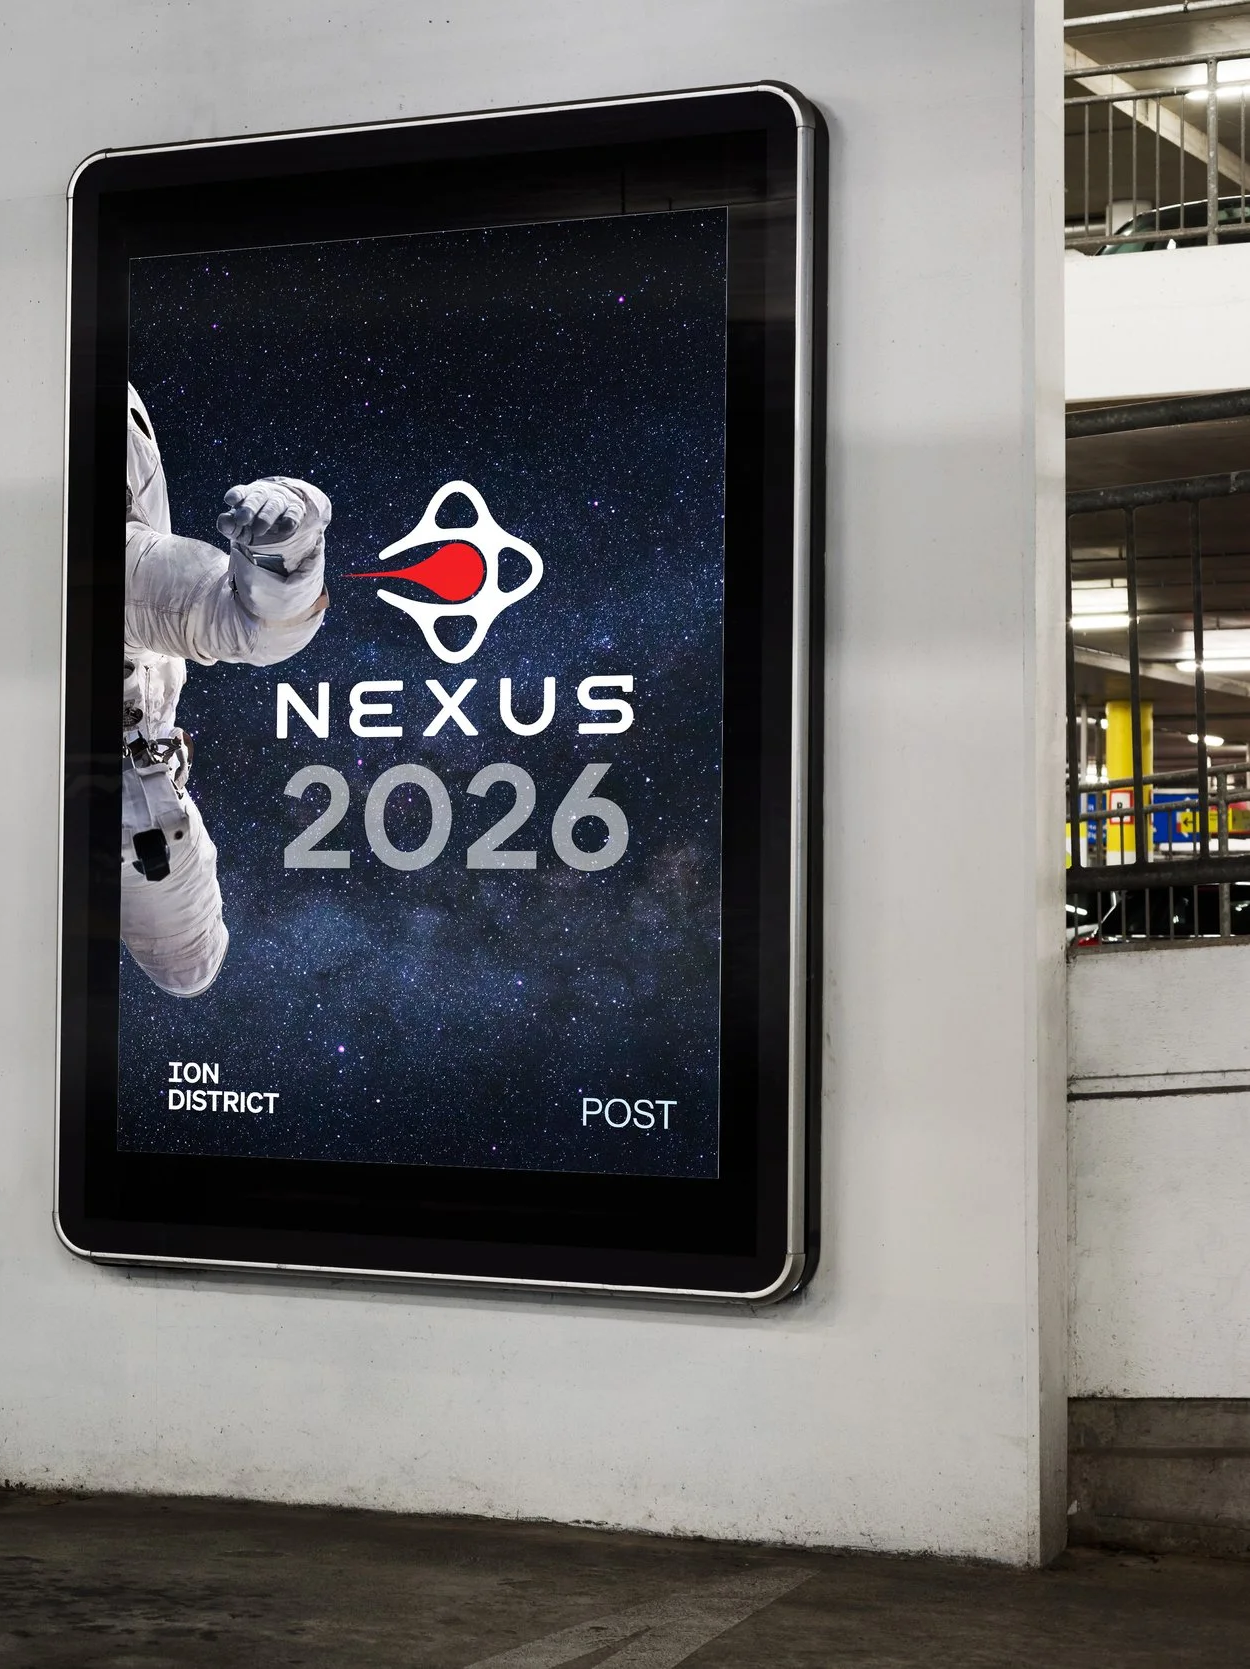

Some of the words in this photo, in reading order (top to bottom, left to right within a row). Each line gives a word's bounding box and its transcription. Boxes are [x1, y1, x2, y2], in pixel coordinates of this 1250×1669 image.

[276, 674, 636, 739] NEXUS
[283, 762, 629, 872] 2026
[168, 1061, 220, 1085] ION
[168, 1088, 280, 1114] DISTRICT
[582, 1097, 678, 1130] POST
